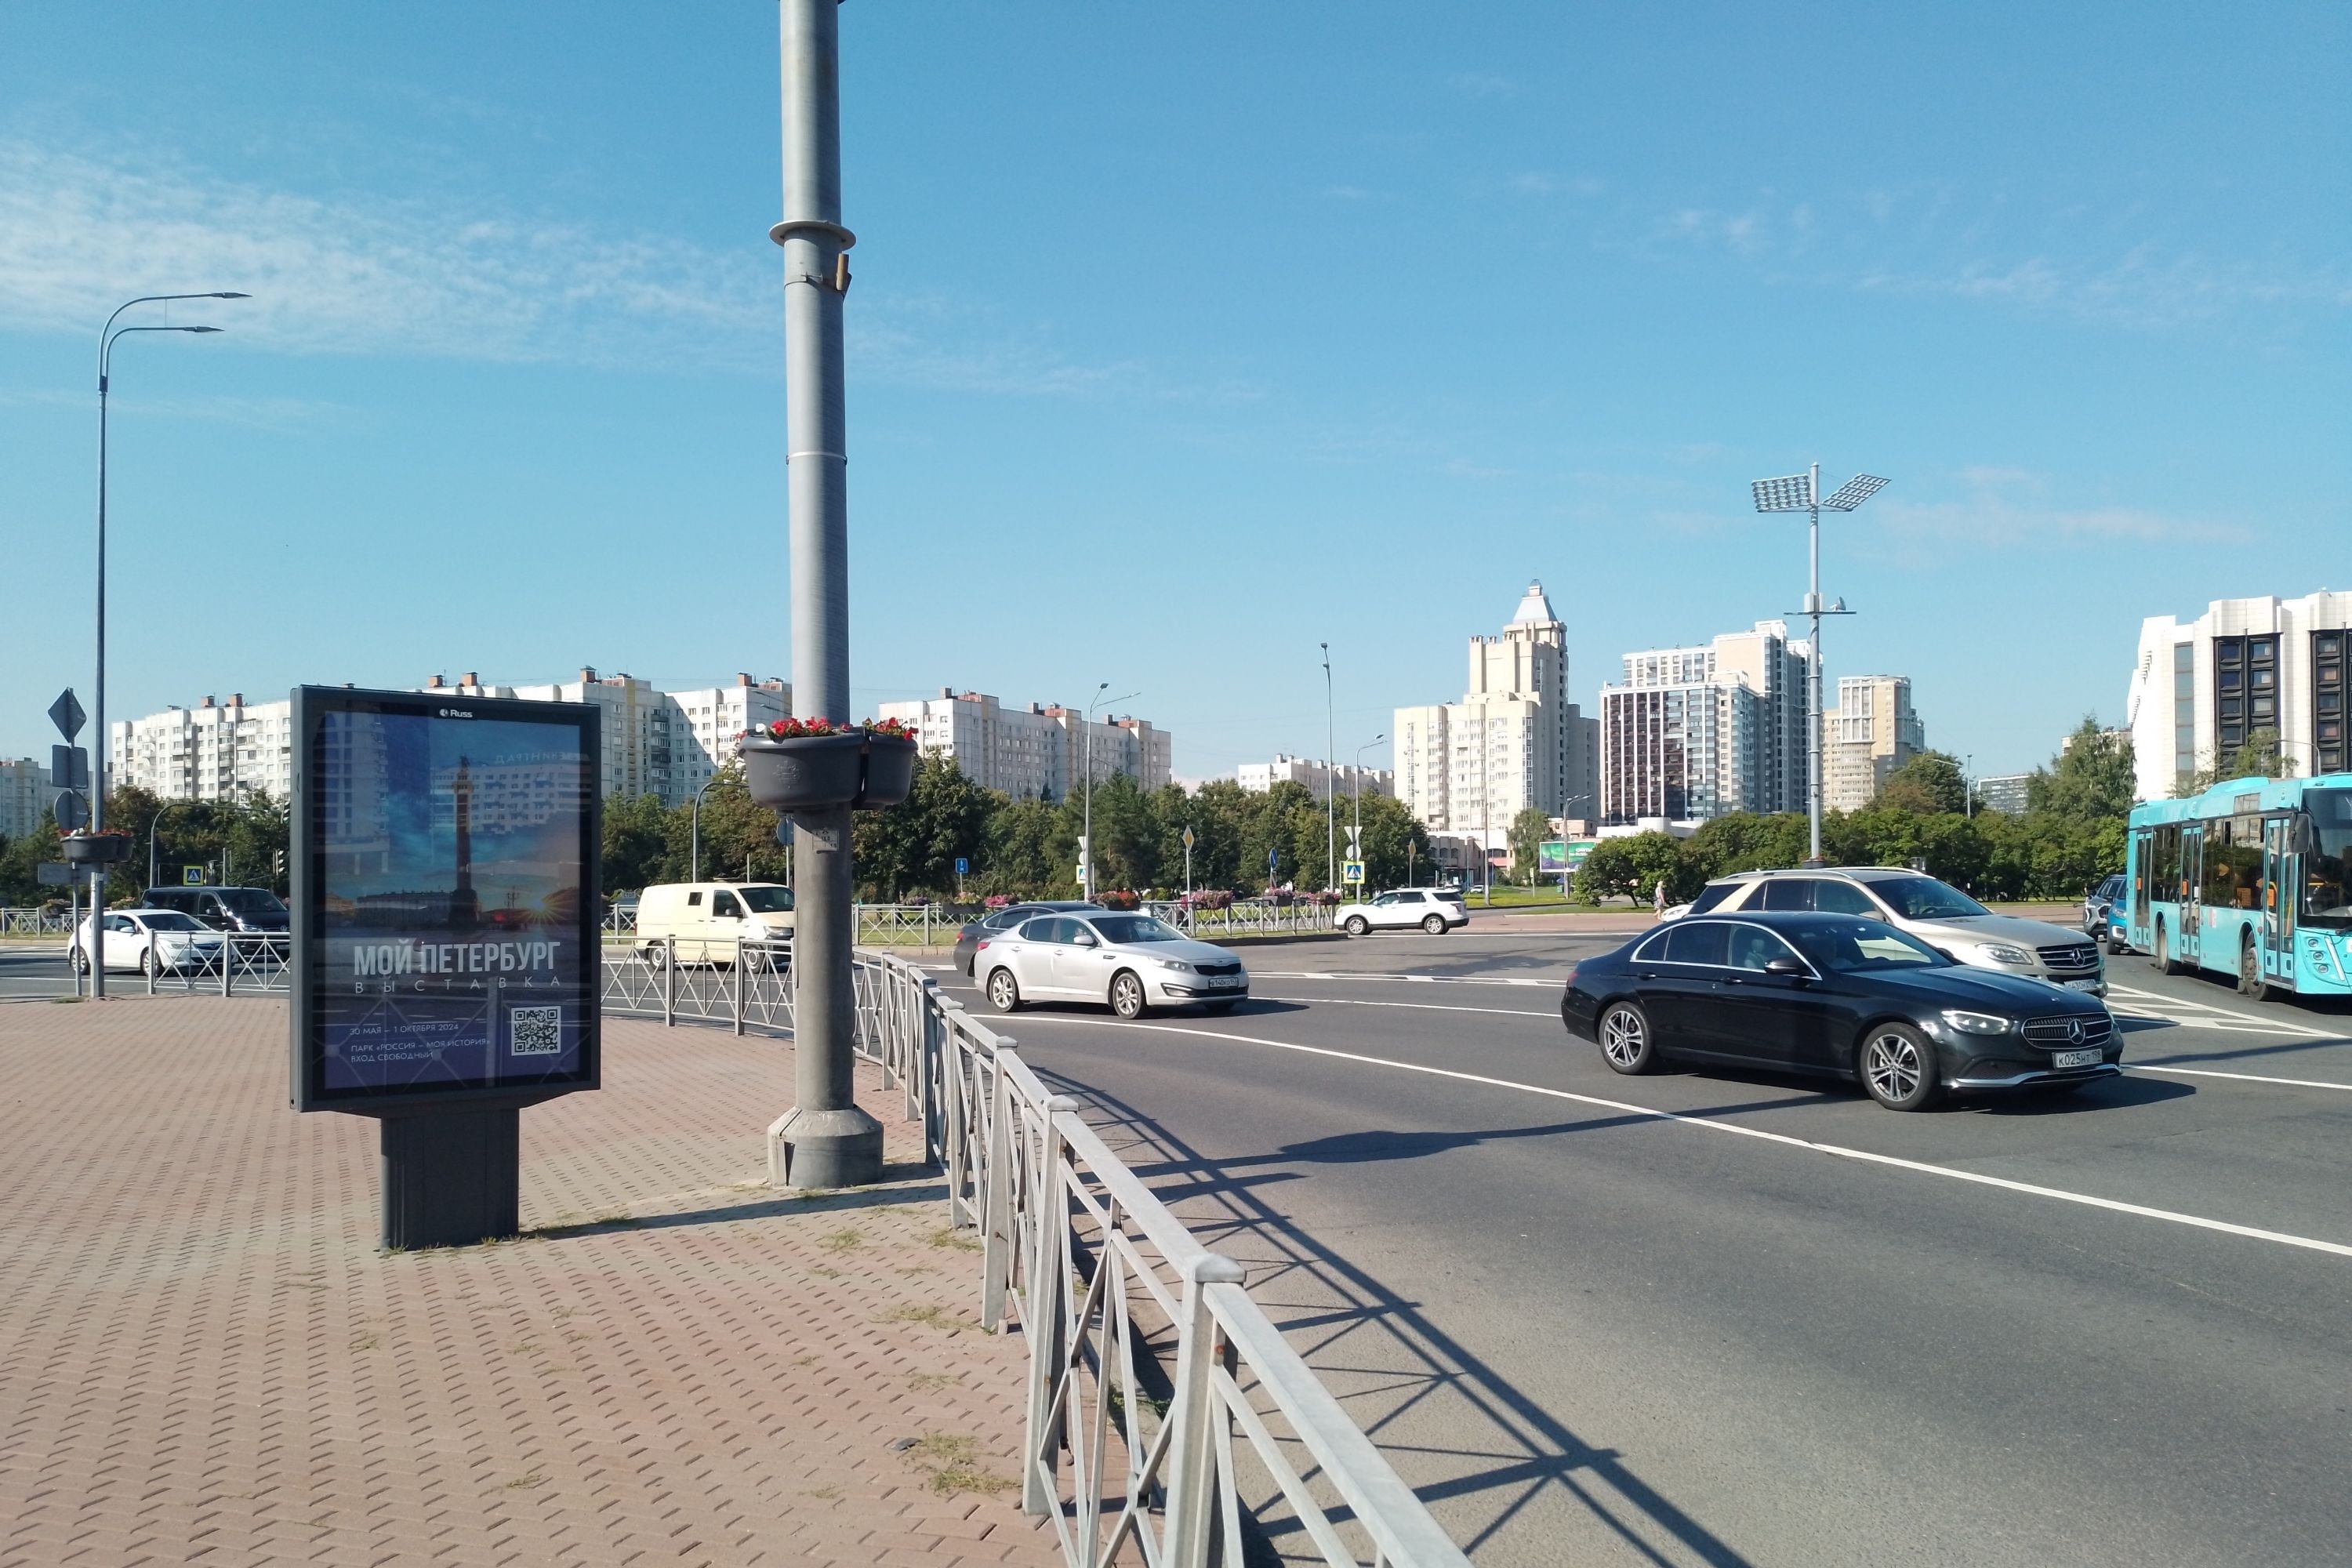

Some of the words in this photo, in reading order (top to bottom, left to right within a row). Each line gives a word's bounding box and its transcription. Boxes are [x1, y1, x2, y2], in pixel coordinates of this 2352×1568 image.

[450, 709, 473, 718] Russ
[354, 938, 412, 975] МОЙ
[420, 942, 561, 974] ПЕТЕРБУРГ
[354, 976, 561, 994] ВЫСТАВКА
[363, 1026, 382, 1035] МАЯ
[400, 1024, 436, 1033] ОКТЯБРЯ
[376, 1042, 416, 1051] «РОССИЯ
[447, 1037, 491, 1047] ИСТОРИЯ»
[350, 1054, 376, 1063] ВХОД
[377, 1051, 434, 1062] СВОБОДНЫЙ
[2058, 1052, 2090, 1066] К025НТ
